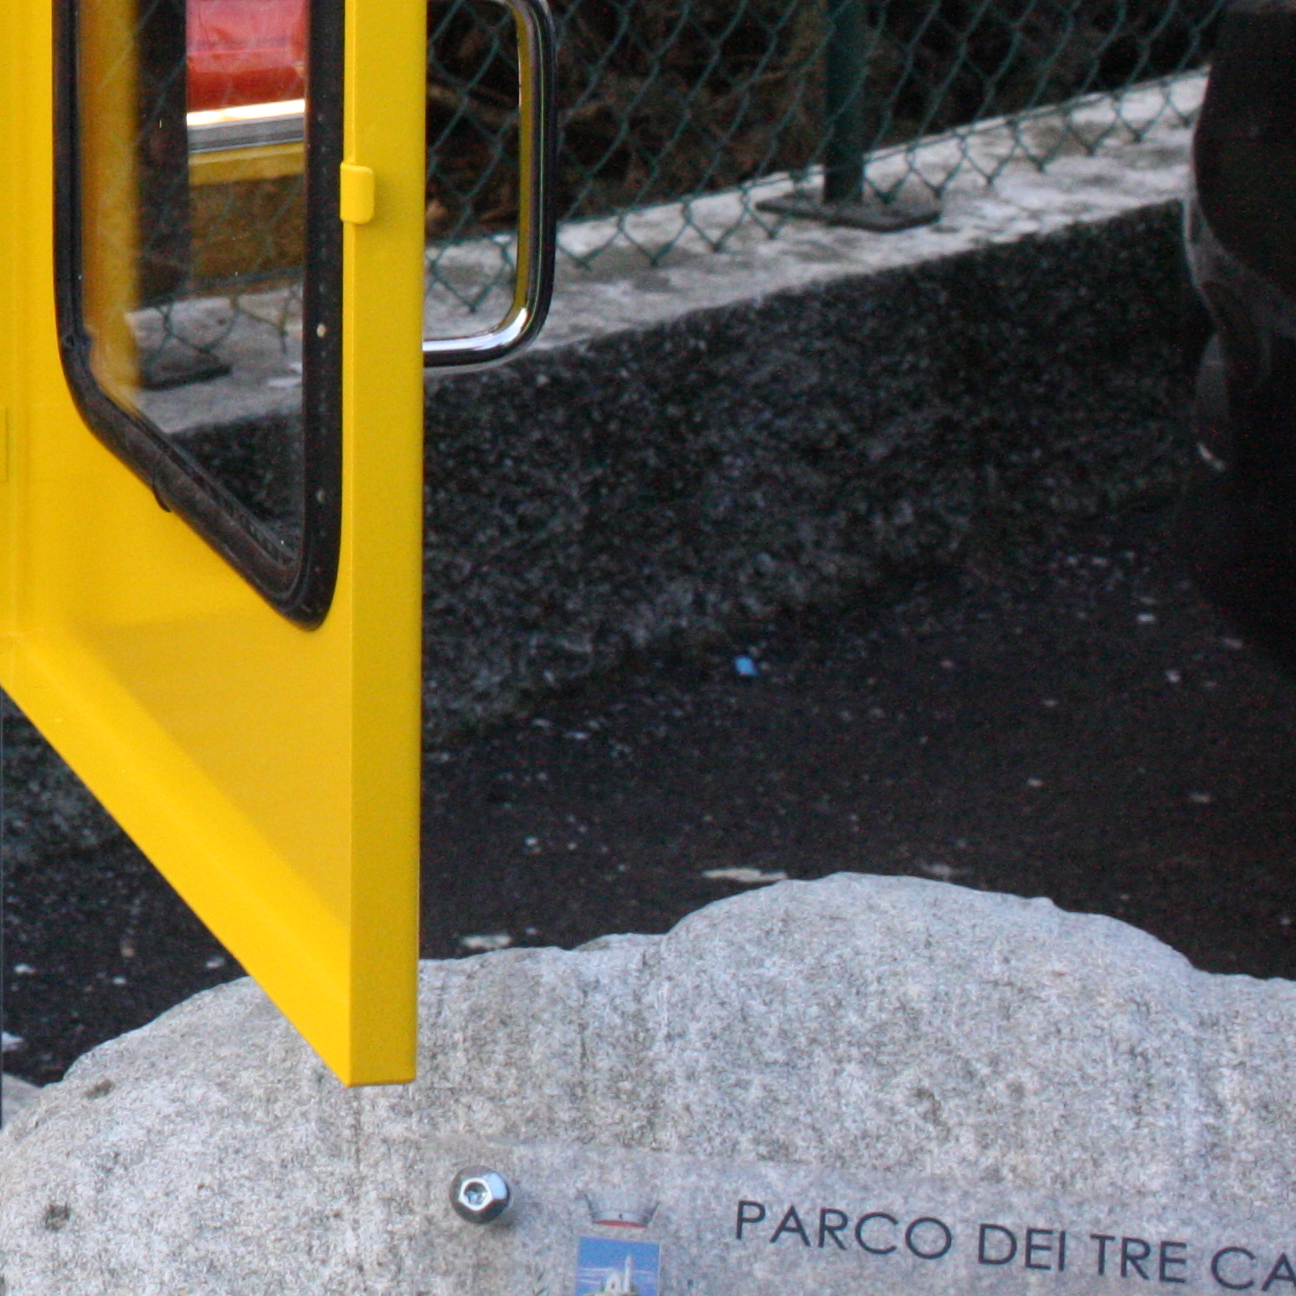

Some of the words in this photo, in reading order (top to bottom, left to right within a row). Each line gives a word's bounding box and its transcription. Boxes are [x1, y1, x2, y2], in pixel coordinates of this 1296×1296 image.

[735, 1199, 953, 1260] PARCO
[978, 1223, 1067, 1272] DEI
[1090, 1234, 1188, 1283] TRE
[1211, 1246, 1296, 1292] CA
